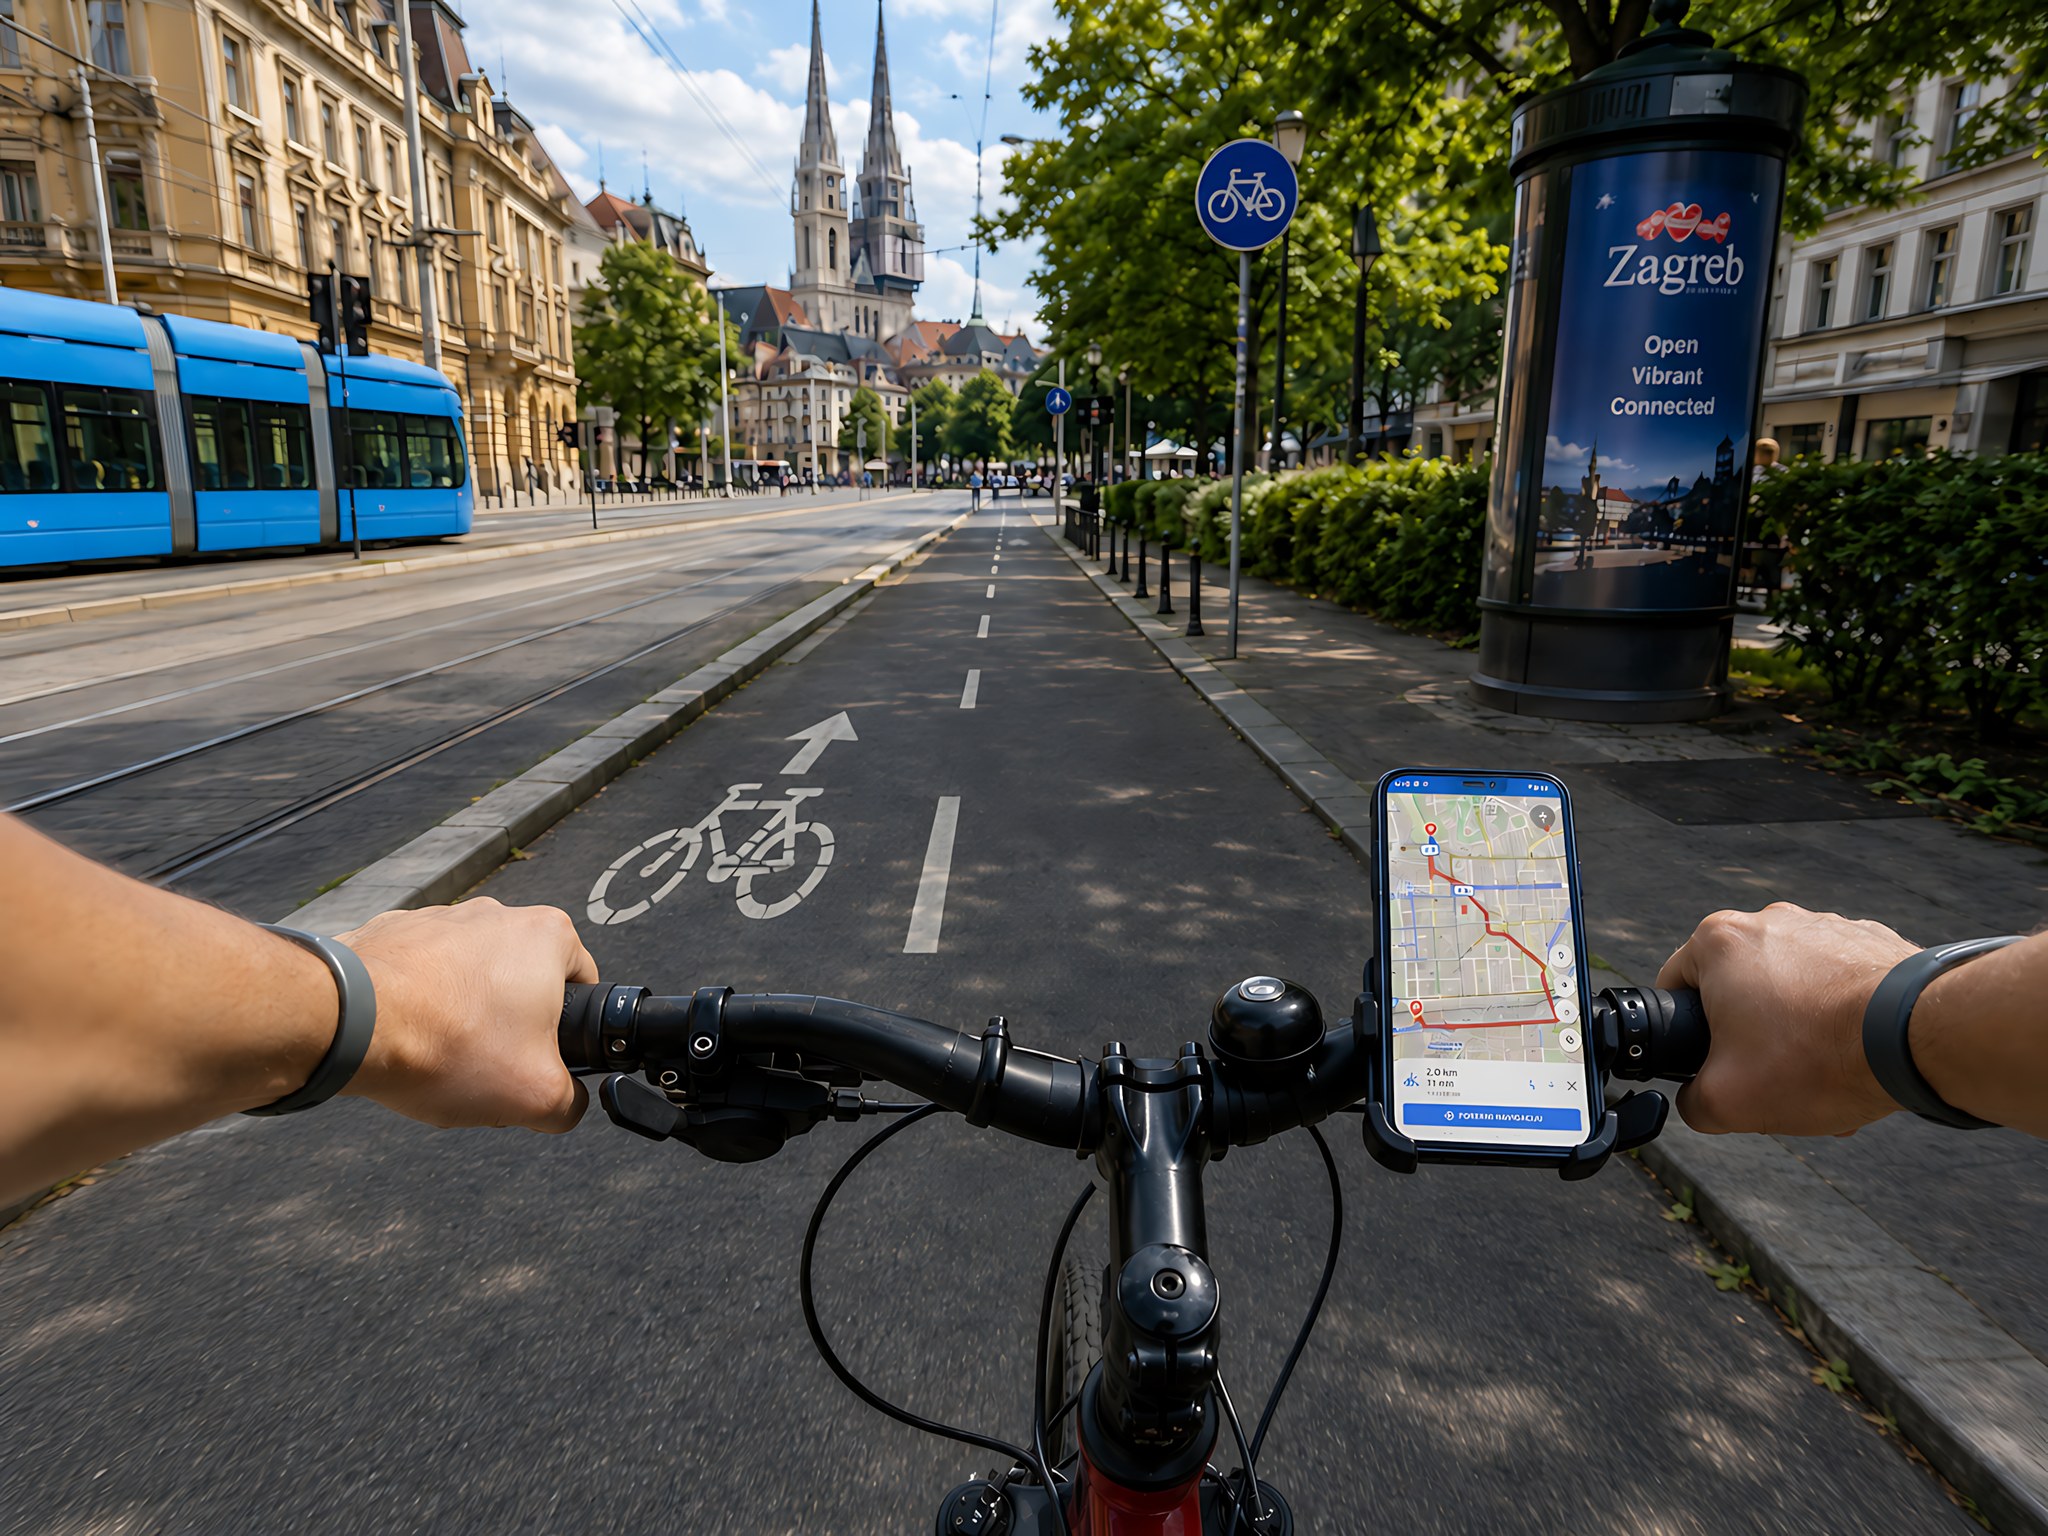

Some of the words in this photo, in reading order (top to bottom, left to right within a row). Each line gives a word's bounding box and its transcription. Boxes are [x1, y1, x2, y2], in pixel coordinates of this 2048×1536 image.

[1603, 243, 1745, 295] Zagreb
[1644, 335, 1699, 358] Open
[1632, 366, 1703, 385] Vibrant
[1611, 396, 1715, 416] Connected
[1443, 1068, 1458, 1077] km
